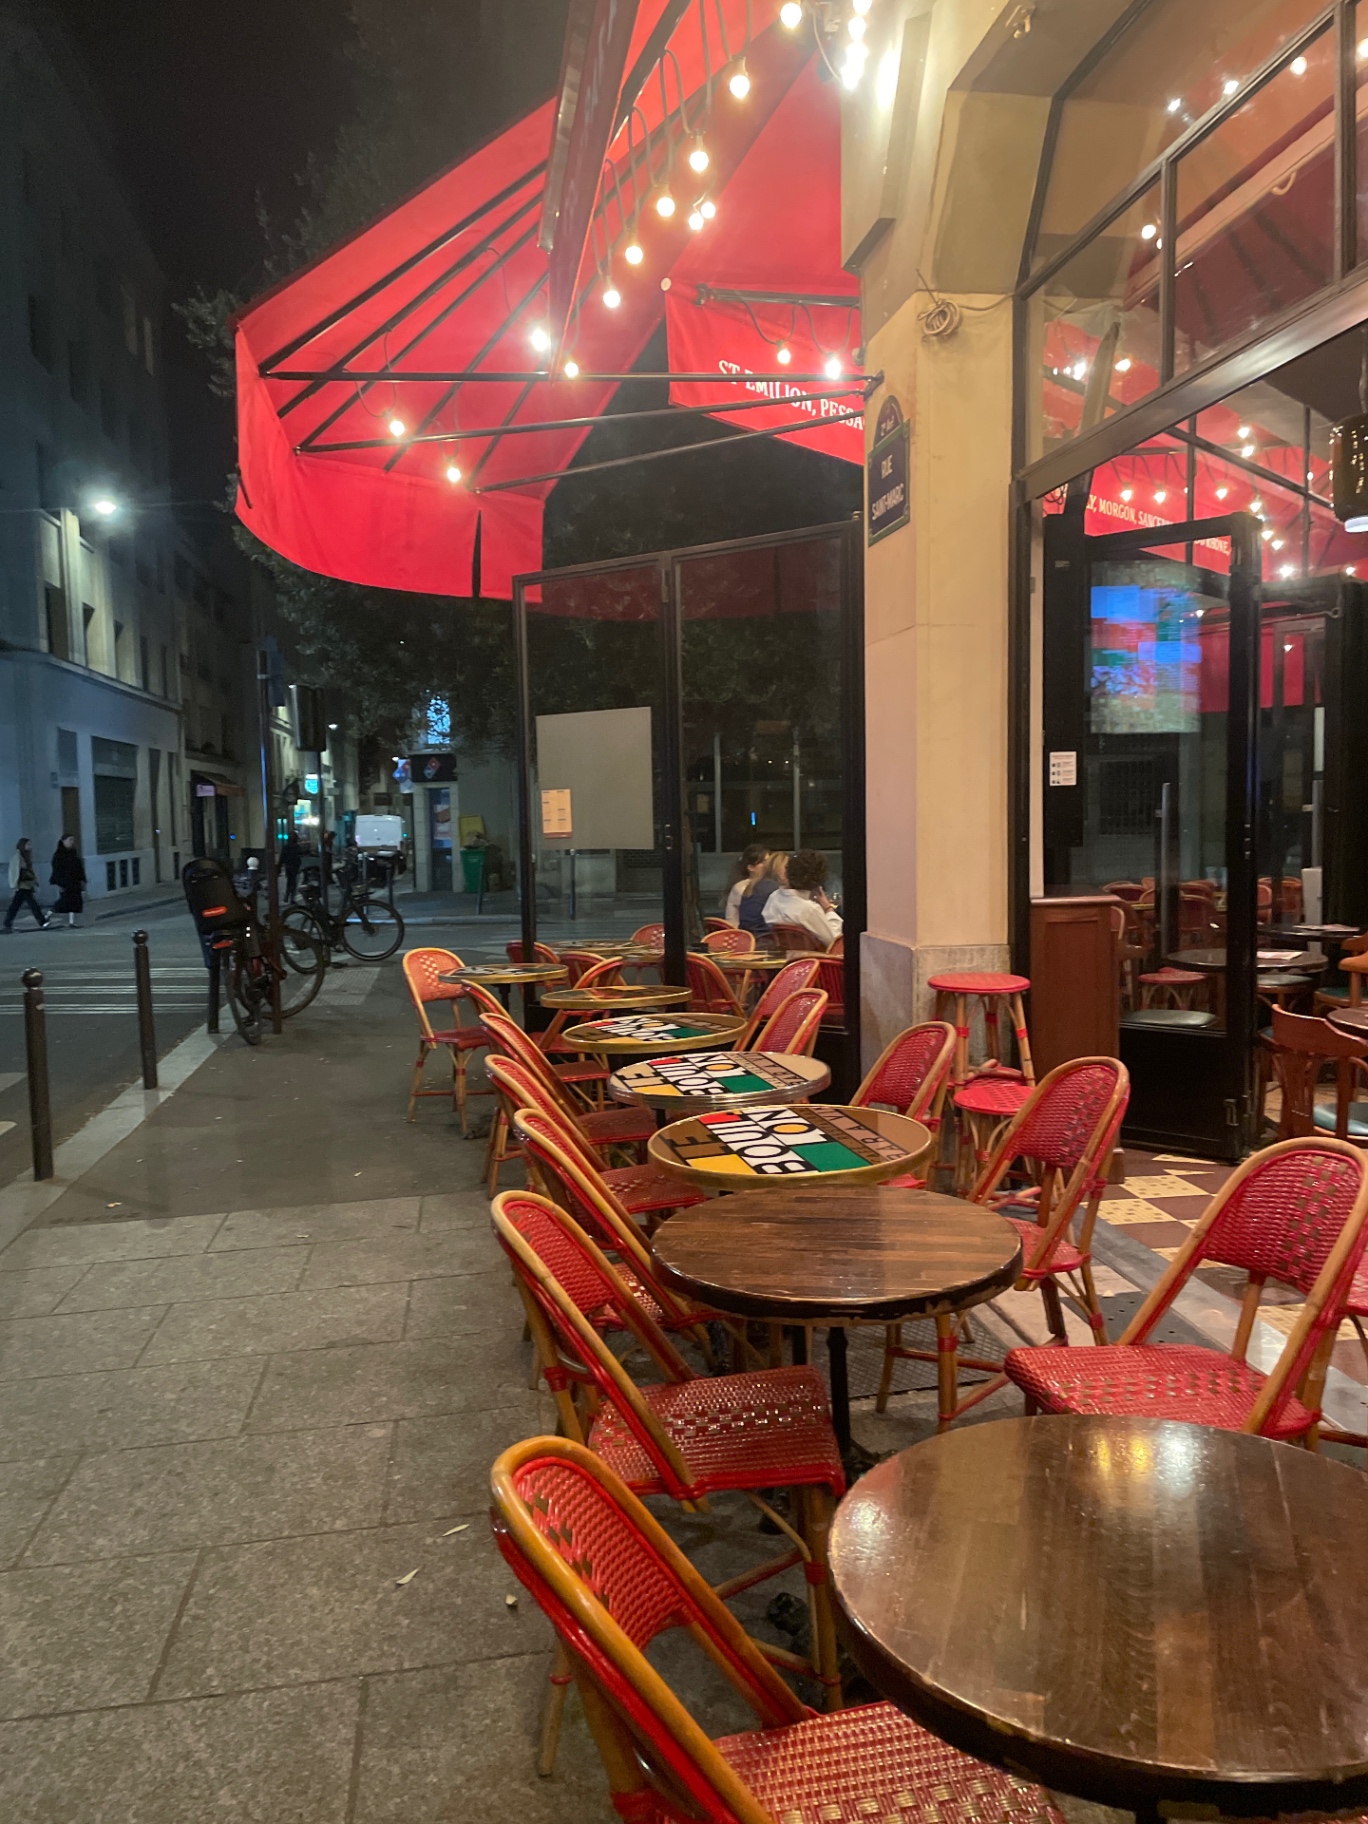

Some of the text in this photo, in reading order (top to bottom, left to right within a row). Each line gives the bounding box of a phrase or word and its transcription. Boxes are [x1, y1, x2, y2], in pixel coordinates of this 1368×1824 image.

[820, 398, 866, 430] PESSA
[881, 454, 893, 479] RUE
[871, 483, 905, 520] SAINT-MARC
[1098, 498, 1137, 525] MORGON,
[1137, 510, 1173, 528] SANCE
[619, 1072, 669, 1088] LE
[687, 1053, 753, 1078] LON
[752, 1107, 836, 1146] LON
[667, 1133, 734, 1160] LE
[705, 1113, 814, 1174] BOUIL
